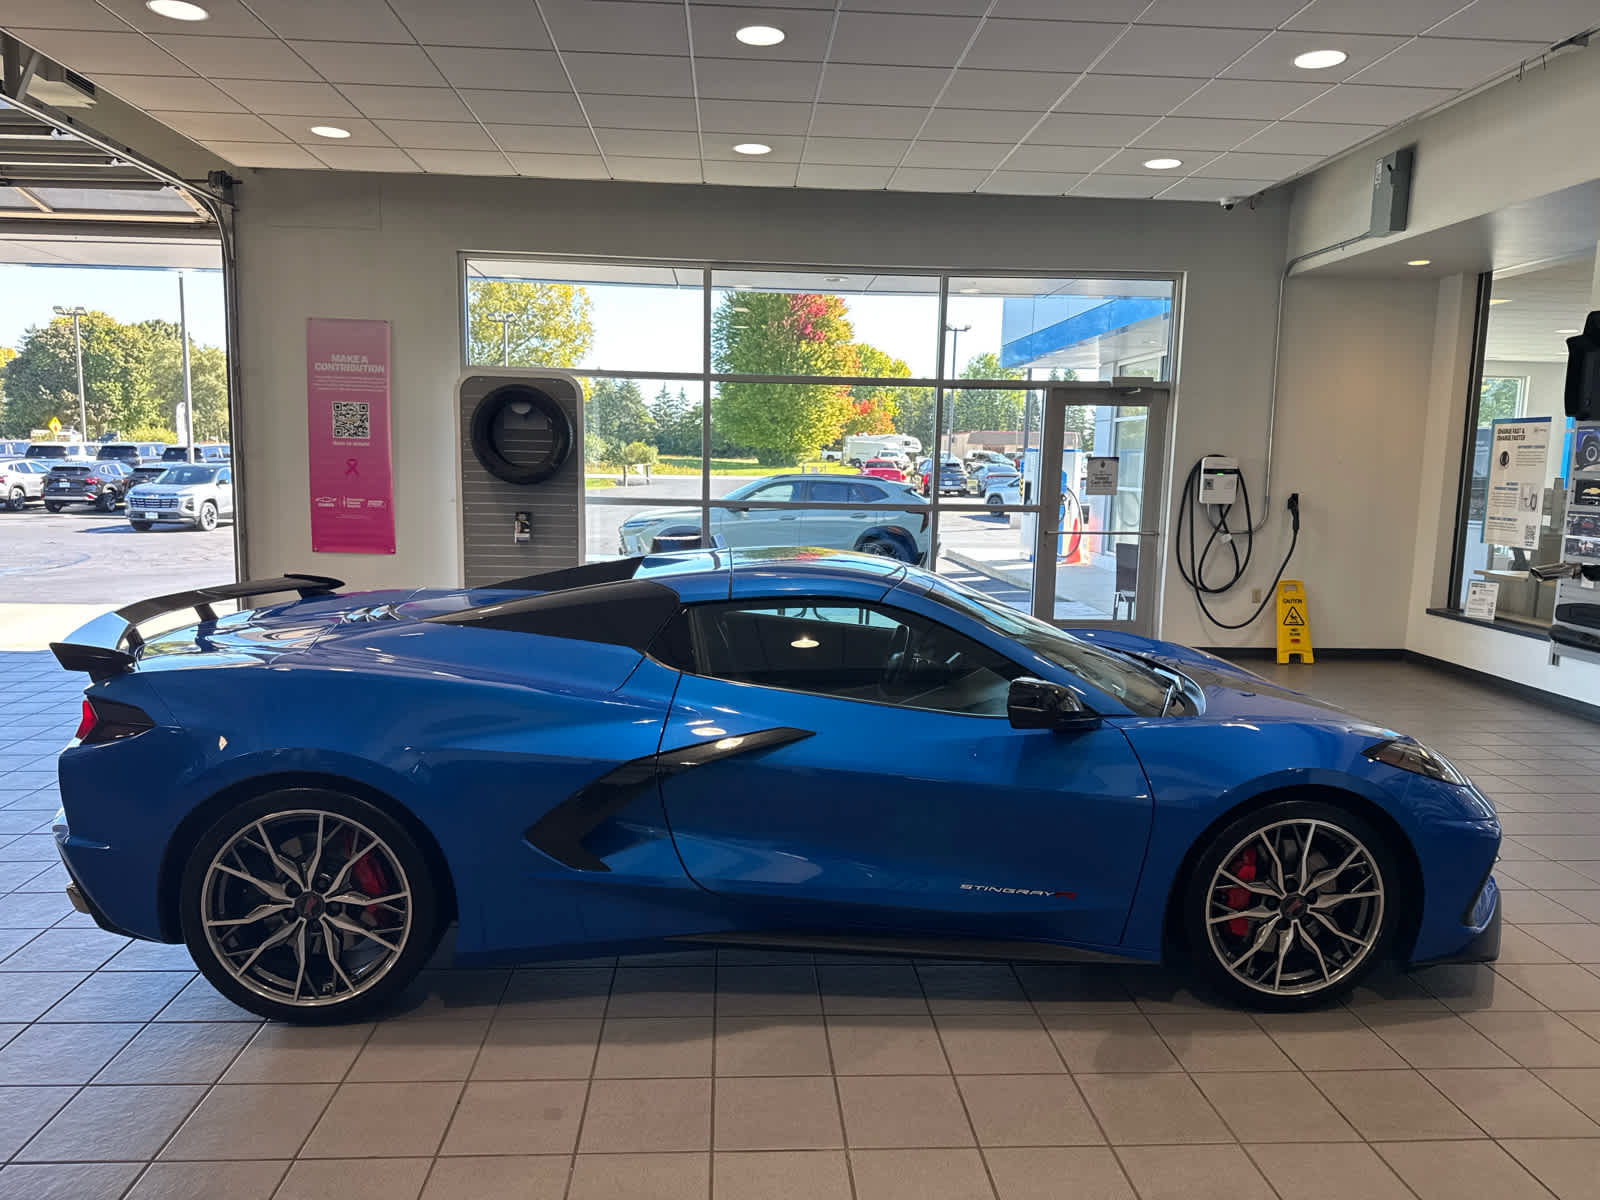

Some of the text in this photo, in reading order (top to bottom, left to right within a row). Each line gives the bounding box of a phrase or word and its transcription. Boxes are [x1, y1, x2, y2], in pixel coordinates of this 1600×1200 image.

[331, 353, 368, 363] MAKE A
[314, 362, 385, 373] CONTRIBUTION
[960, 884, 1055, 896] STINGRAY
